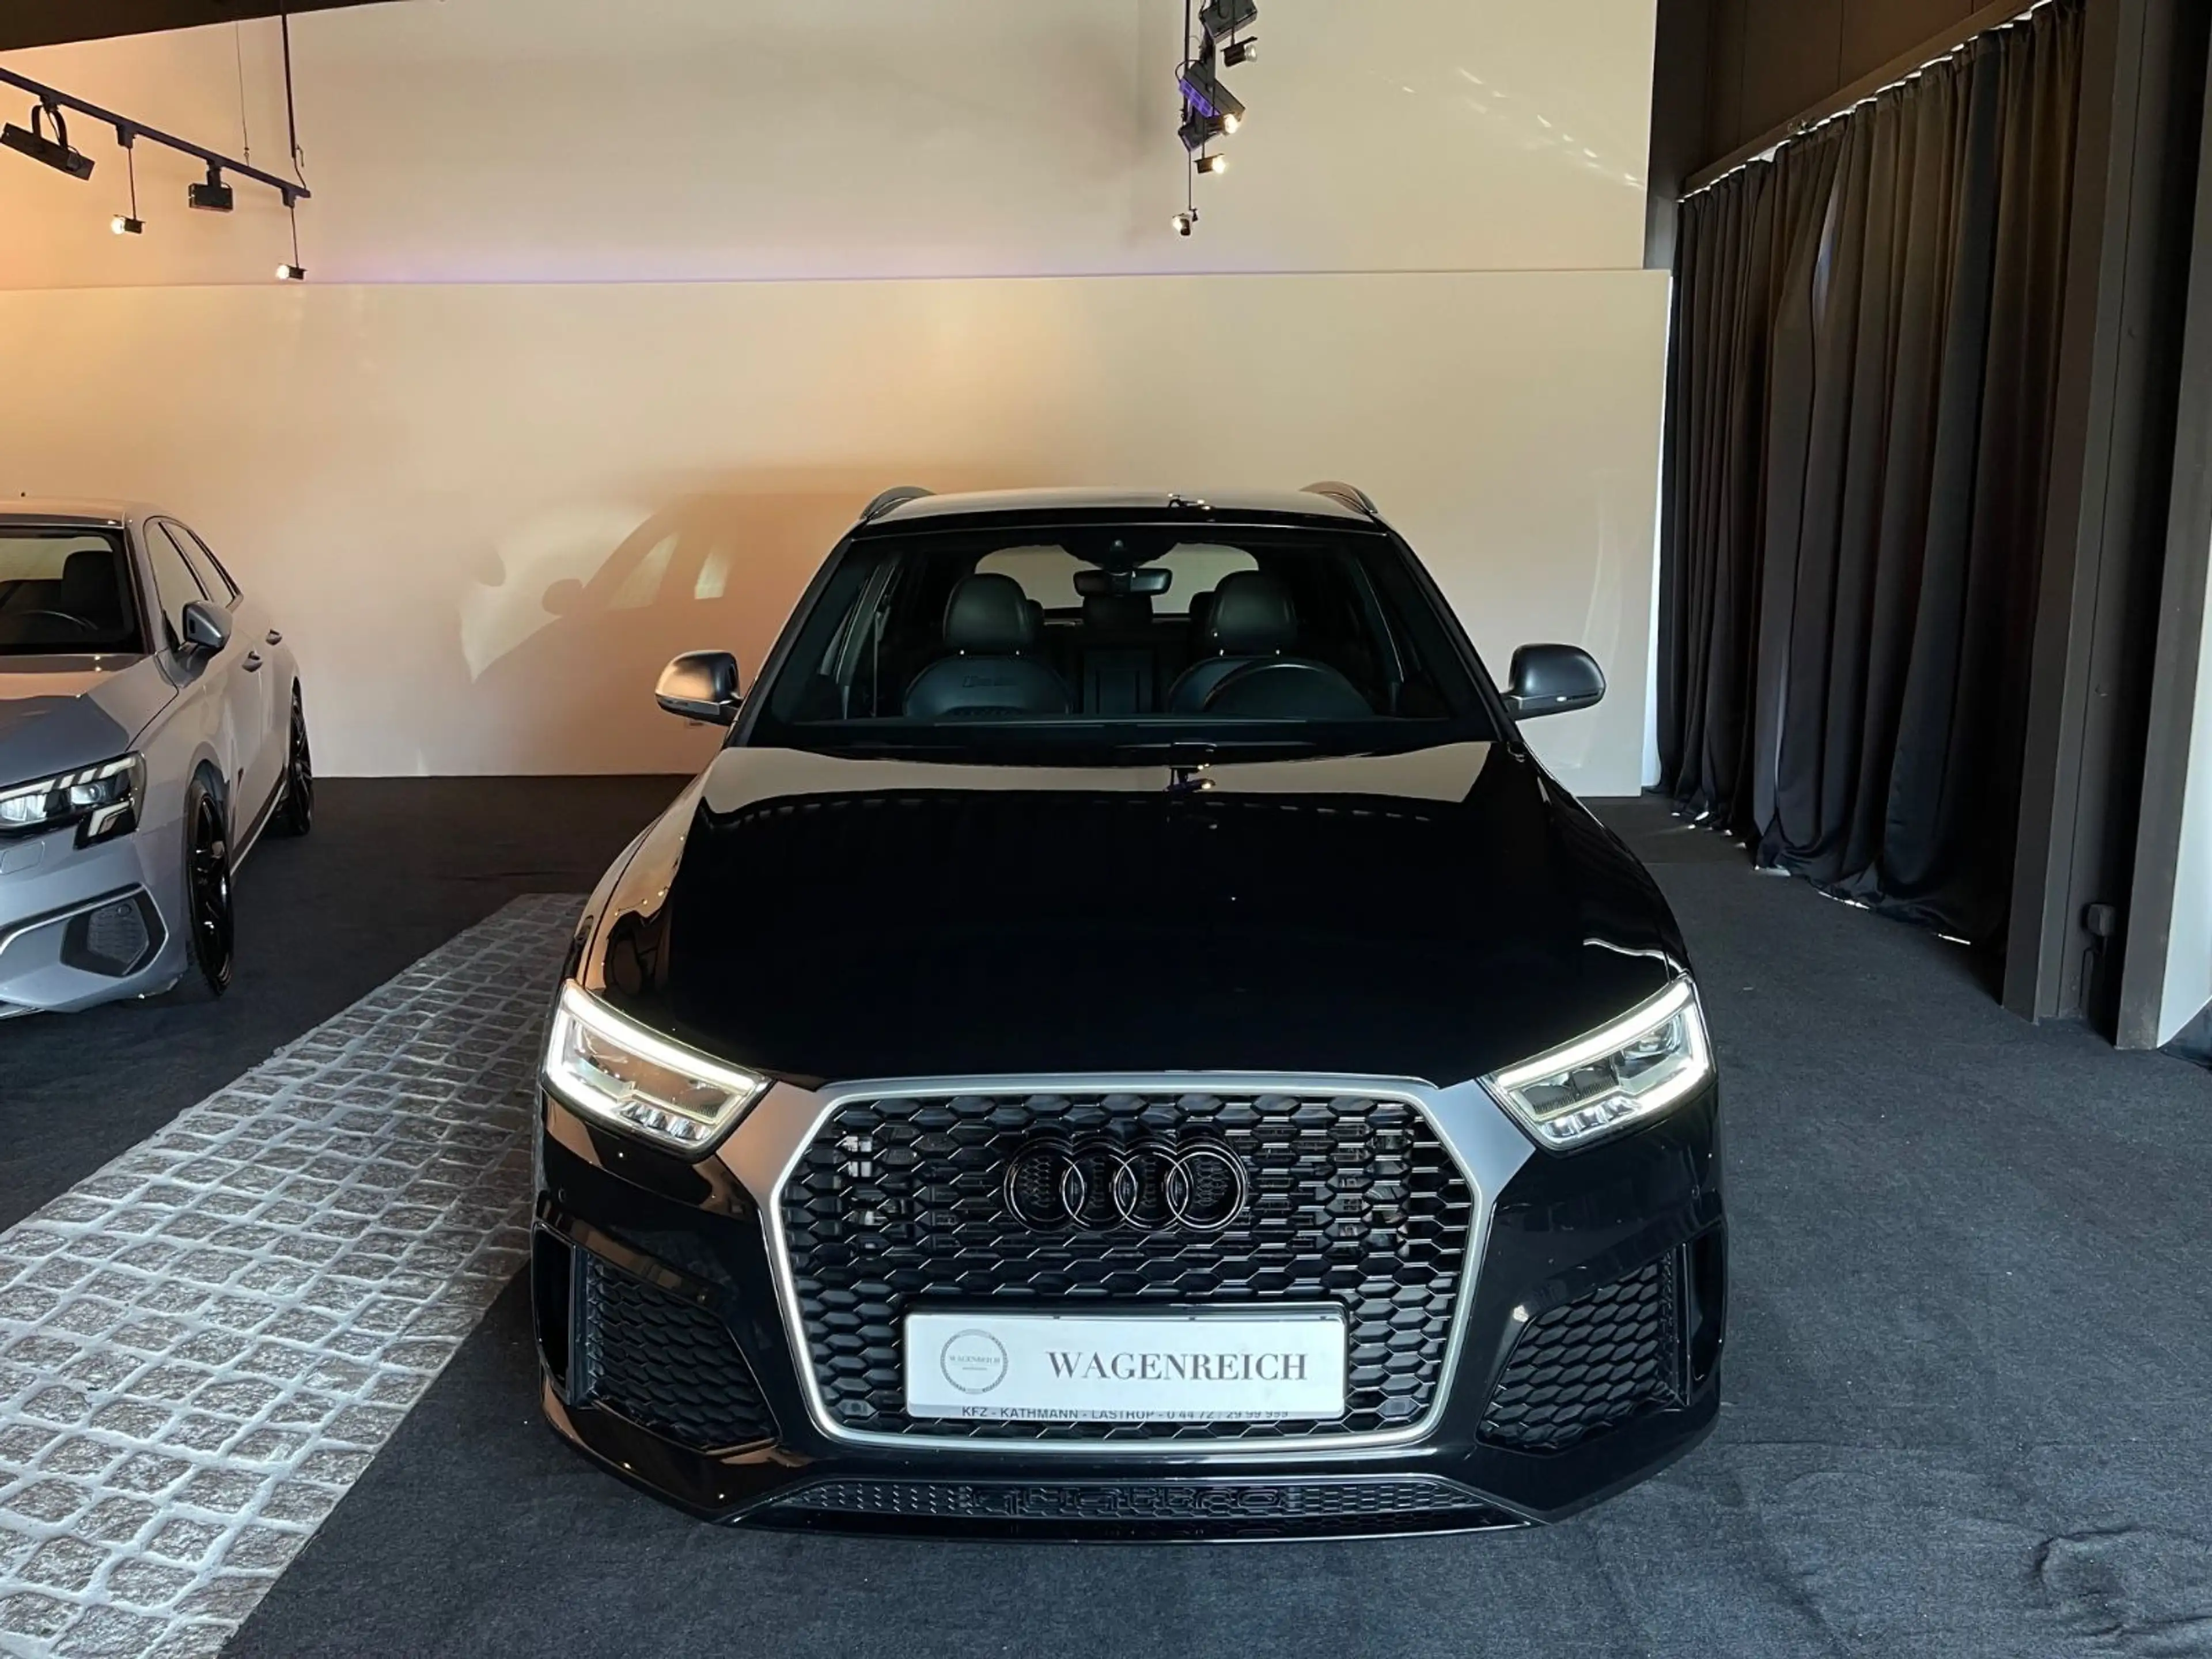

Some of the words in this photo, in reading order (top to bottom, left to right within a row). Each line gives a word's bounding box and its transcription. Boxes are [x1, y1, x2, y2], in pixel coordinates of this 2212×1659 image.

[1046, 1351, 1308, 1381] WAGENREICH
[962, 1406, 987, 1416] KFZ
[1001, 1407, 1078, 1419] KATHMANN
